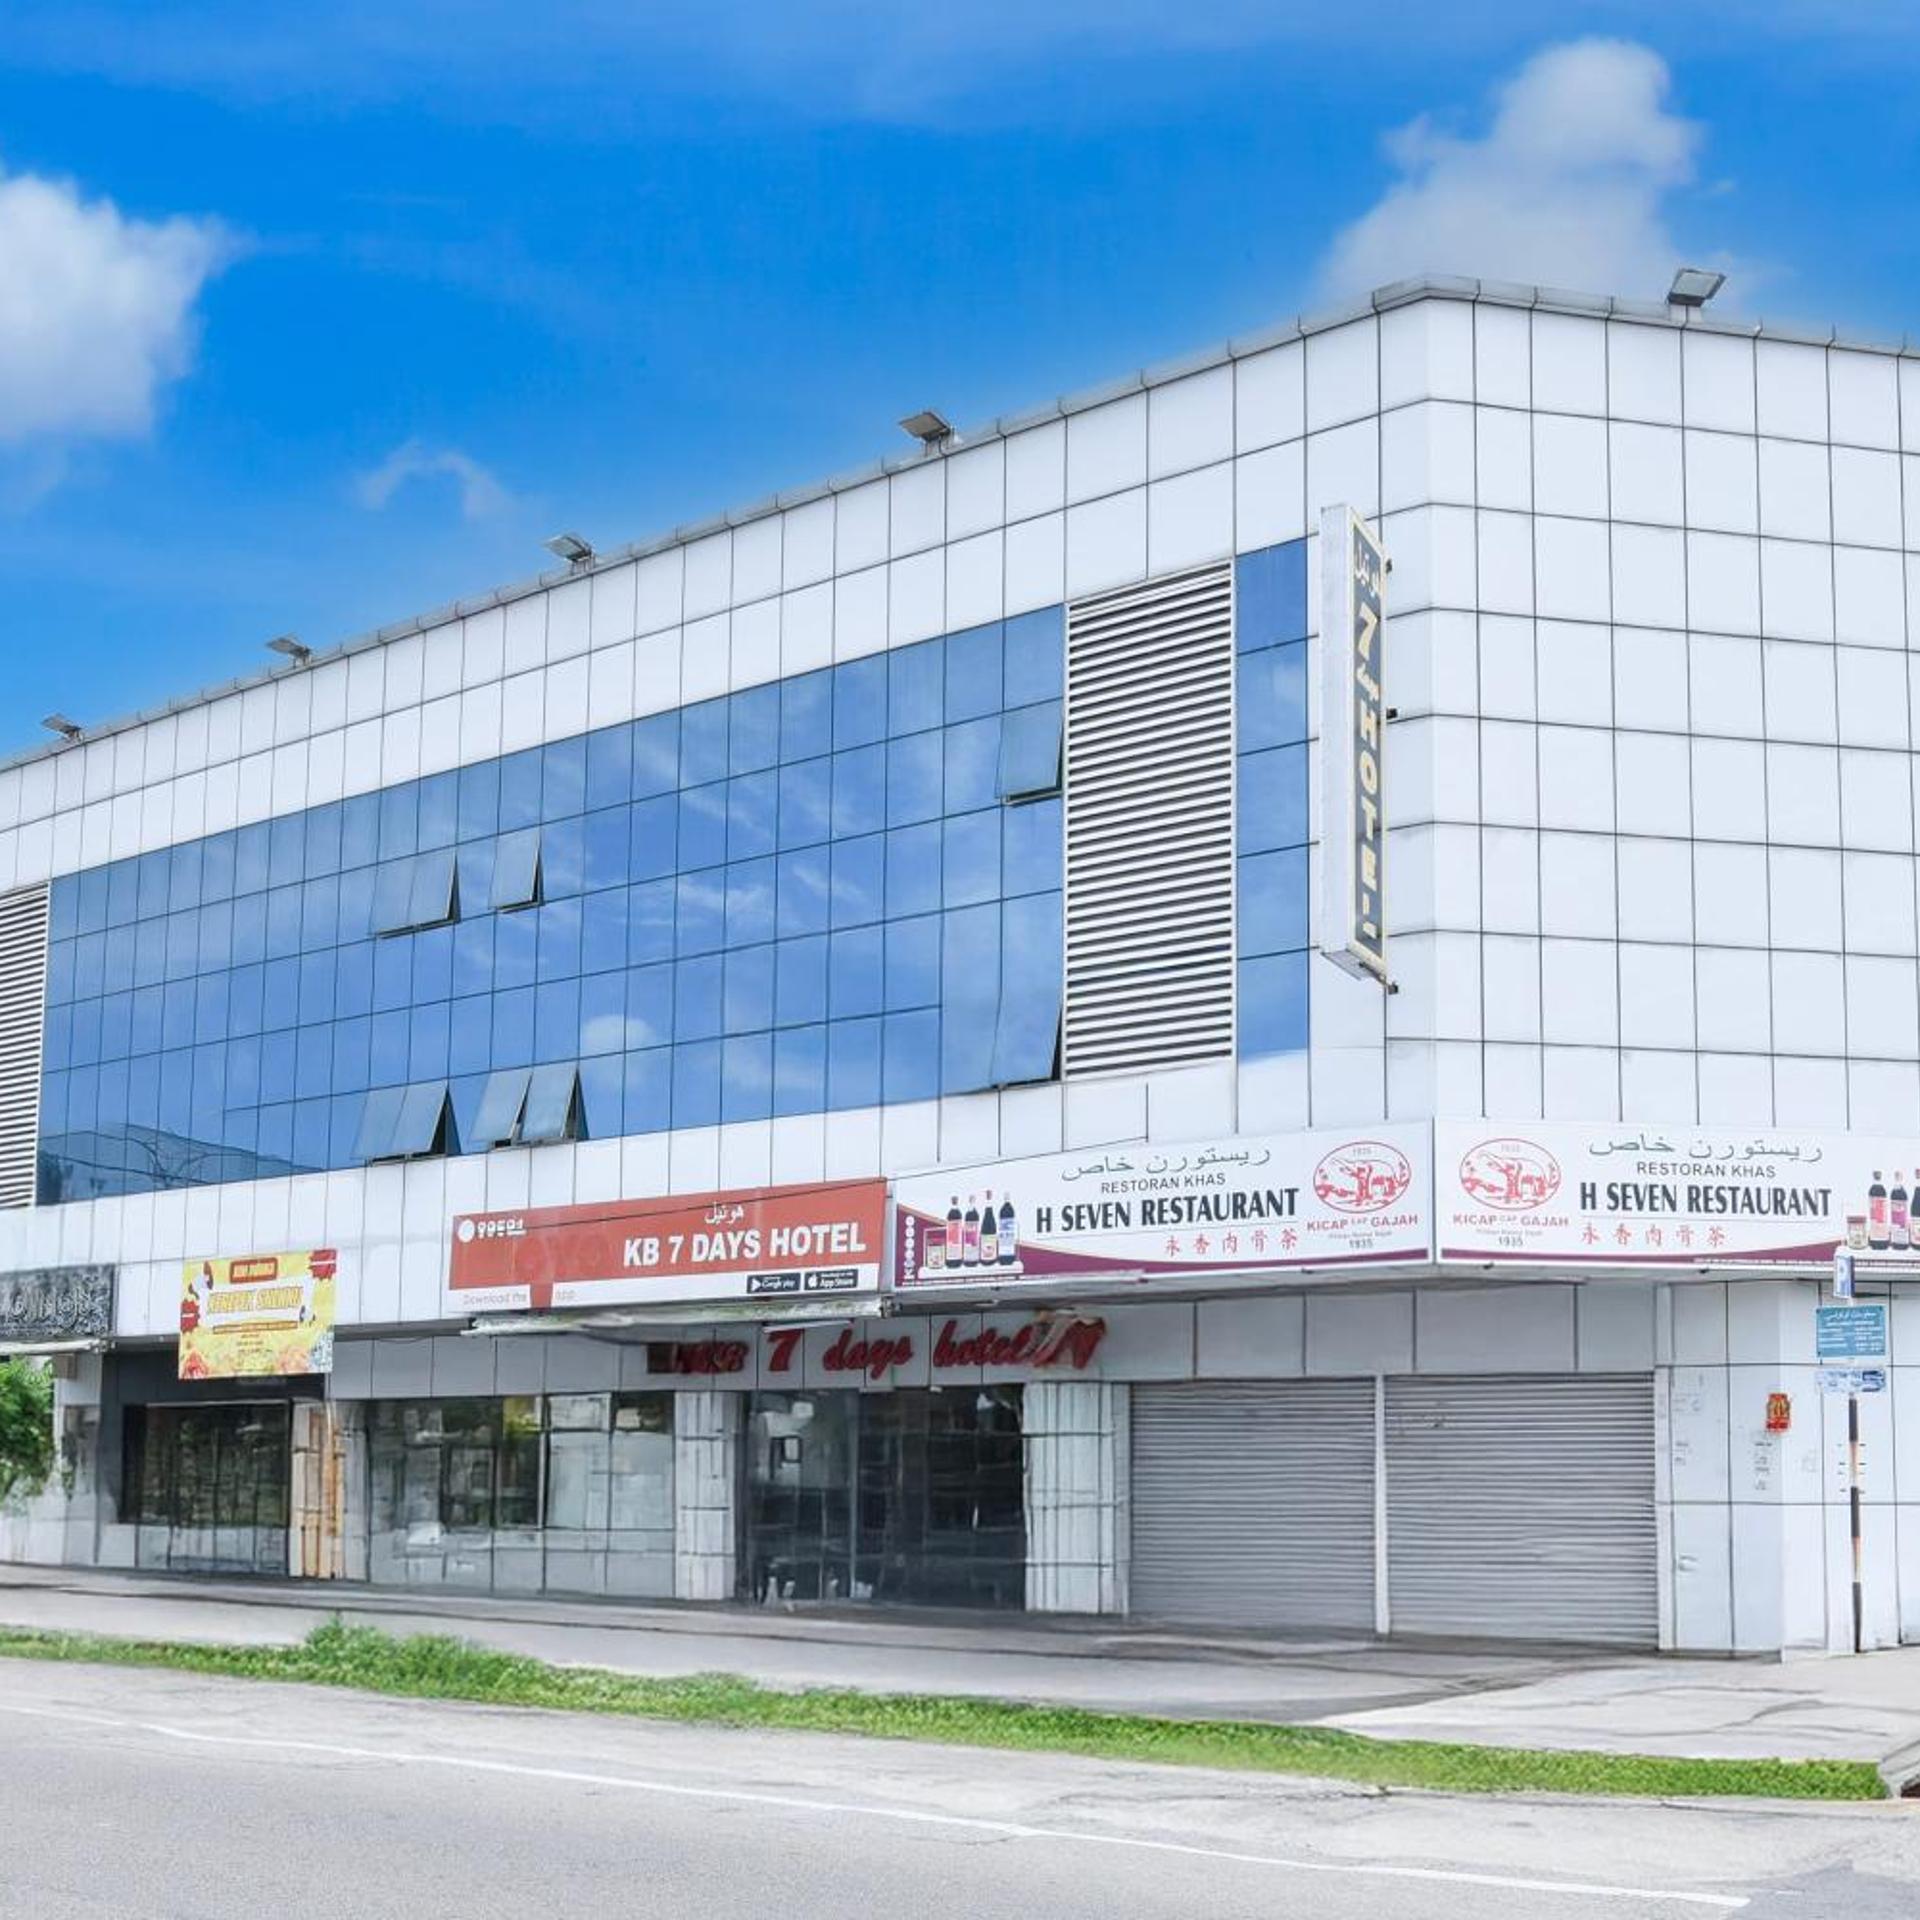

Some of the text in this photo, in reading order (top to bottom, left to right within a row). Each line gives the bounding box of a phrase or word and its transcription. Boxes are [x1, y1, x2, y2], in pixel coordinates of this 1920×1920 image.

[1358, 602, 1378, 661] 7
[1588, 1134, 1676, 1156] خاص
[1061, 1155, 1134, 1181] خاص
[1637, 1162, 1777, 1178] RESTORAN KHAS
[1100, 1172, 1227, 1194] RESTORAN KHAS
[1036, 1188, 1299, 1233] H SEVEN RESTAURANT
[1580, 1182, 1832, 1216] H SEVEN RESTAURANT
[1306, 1218, 1348, 1231] KICAP
[1370, 1214, 1418, 1227] GAJAH
[1453, 1214, 1497, 1225] KICAP
[1520, 1215, 1569, 1227] GAJAH
[623, 1237, 660, 1267] KB
[667, 1235, 685, 1263] 7
[691, 1230, 760, 1262] DAYS
[769, 1222, 867, 1257] HOTEL
[767, 1328, 805, 1372] 7
[822, 1328, 914, 1380] days
[933, 1319, 1035, 1368] hotel
